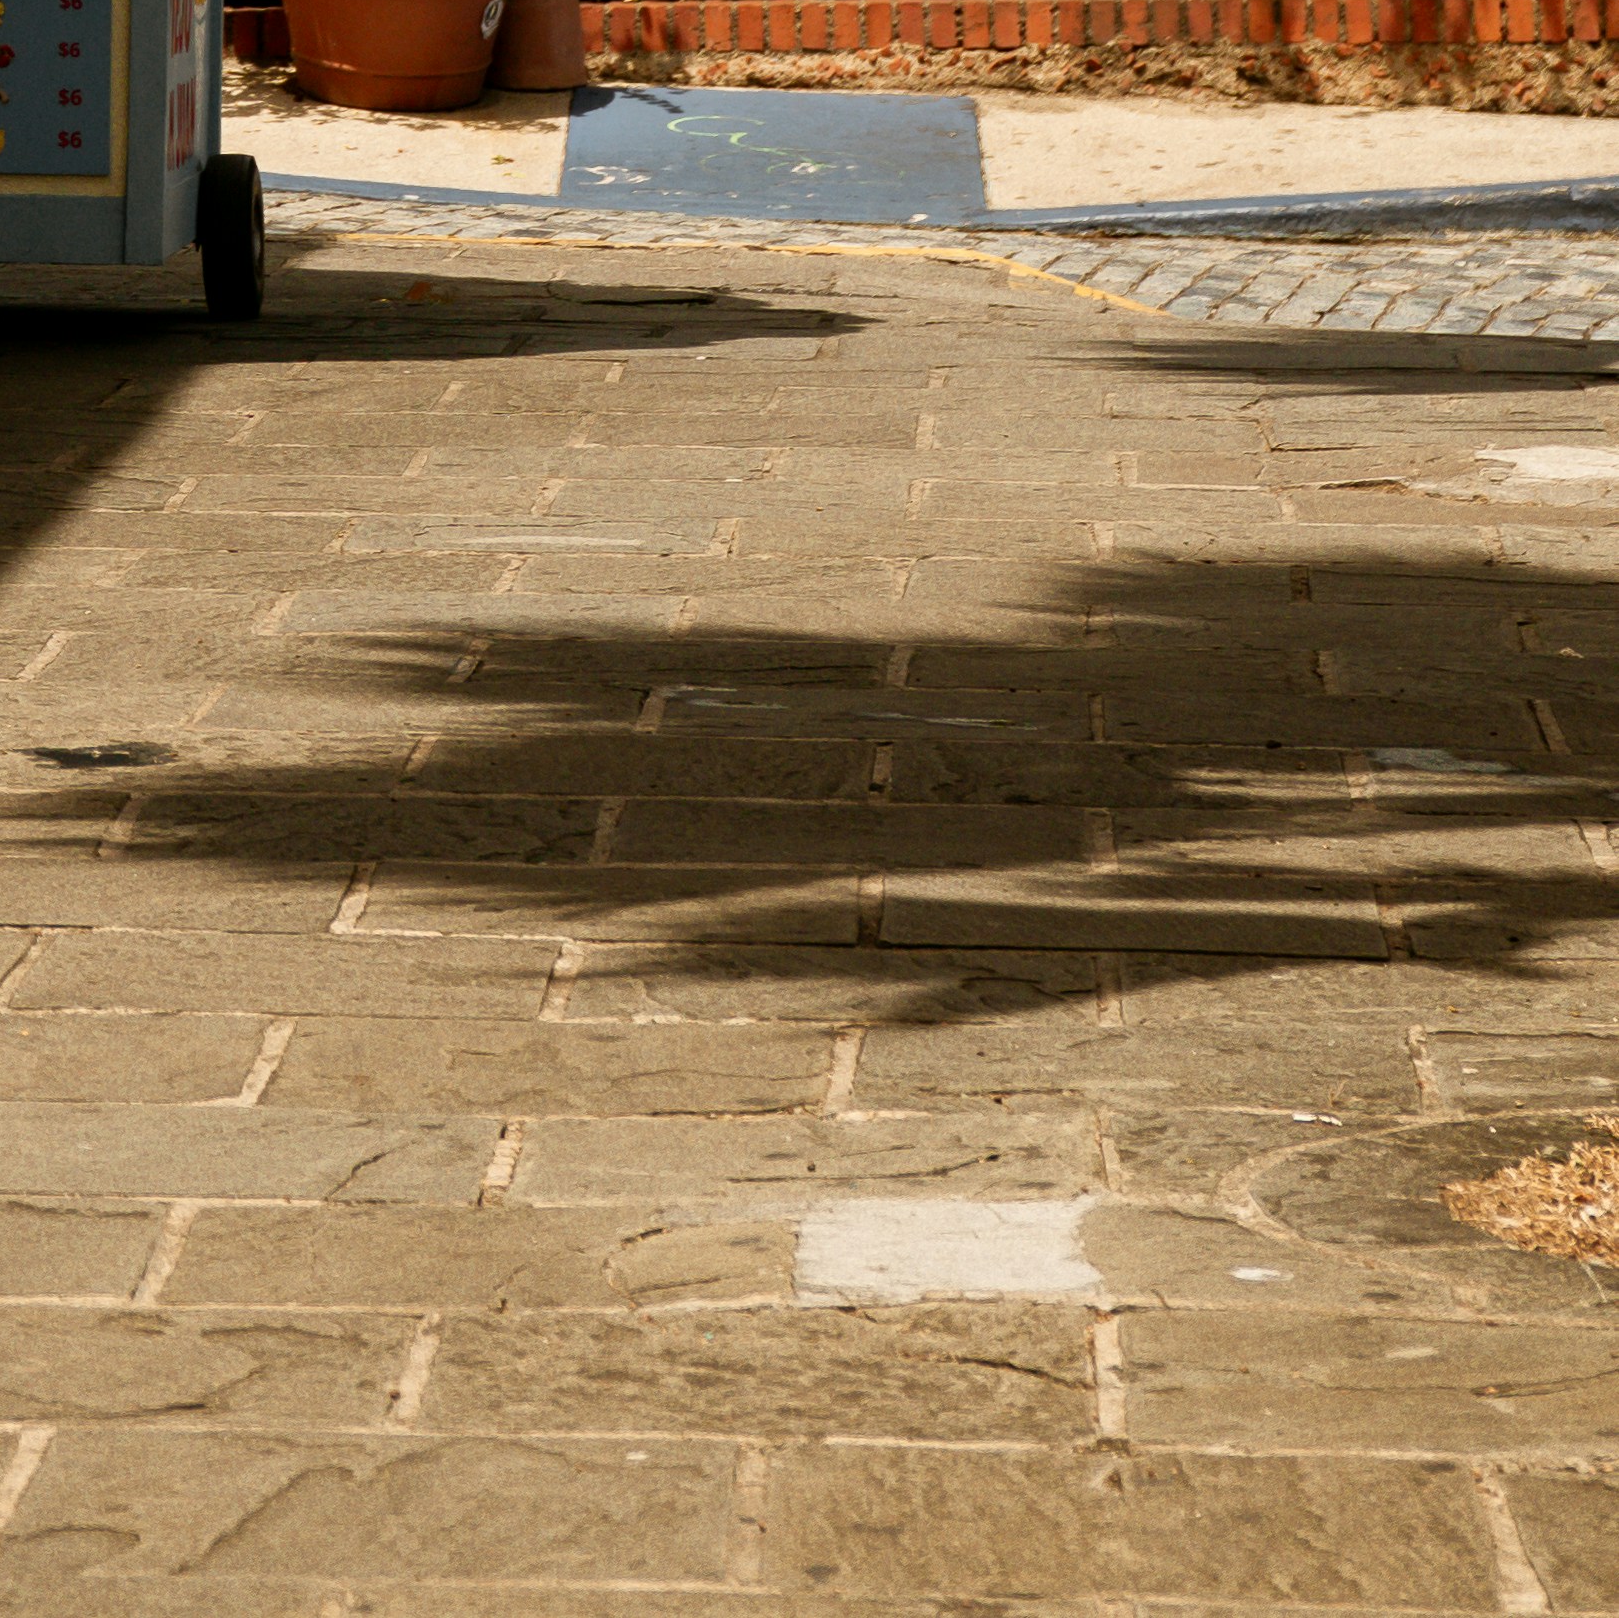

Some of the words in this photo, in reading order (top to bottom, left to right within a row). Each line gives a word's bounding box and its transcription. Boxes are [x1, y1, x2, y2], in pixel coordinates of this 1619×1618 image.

[61, 42, 80, 58] $6
[59, 89, 82, 105] $6
[58, 132, 81, 149] $6
